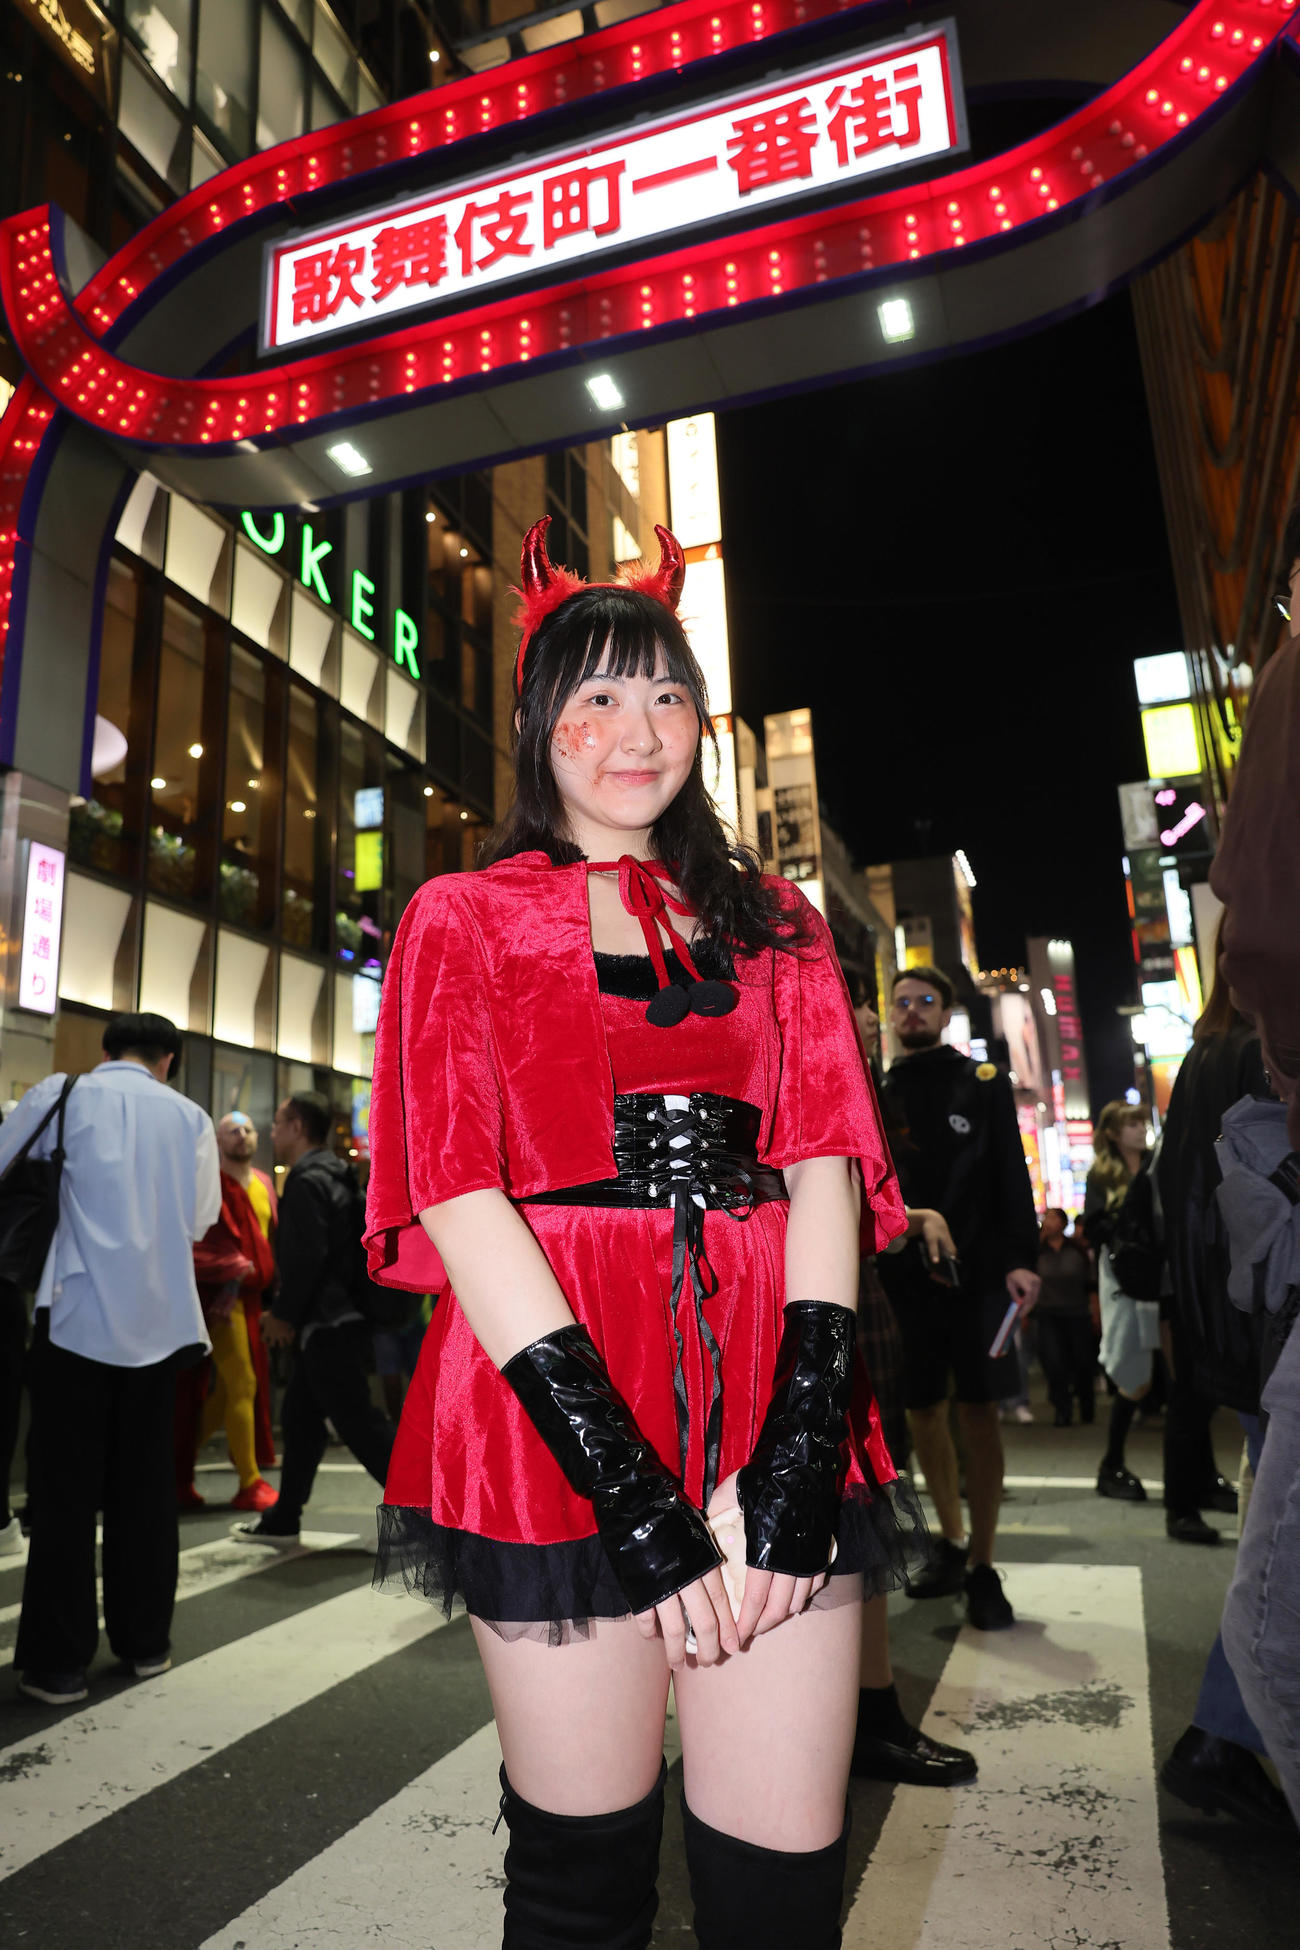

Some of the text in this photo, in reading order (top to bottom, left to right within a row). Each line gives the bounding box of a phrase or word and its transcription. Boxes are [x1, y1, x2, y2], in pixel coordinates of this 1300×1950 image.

[293, 63, 923, 326] 歌舞伎町一番街
